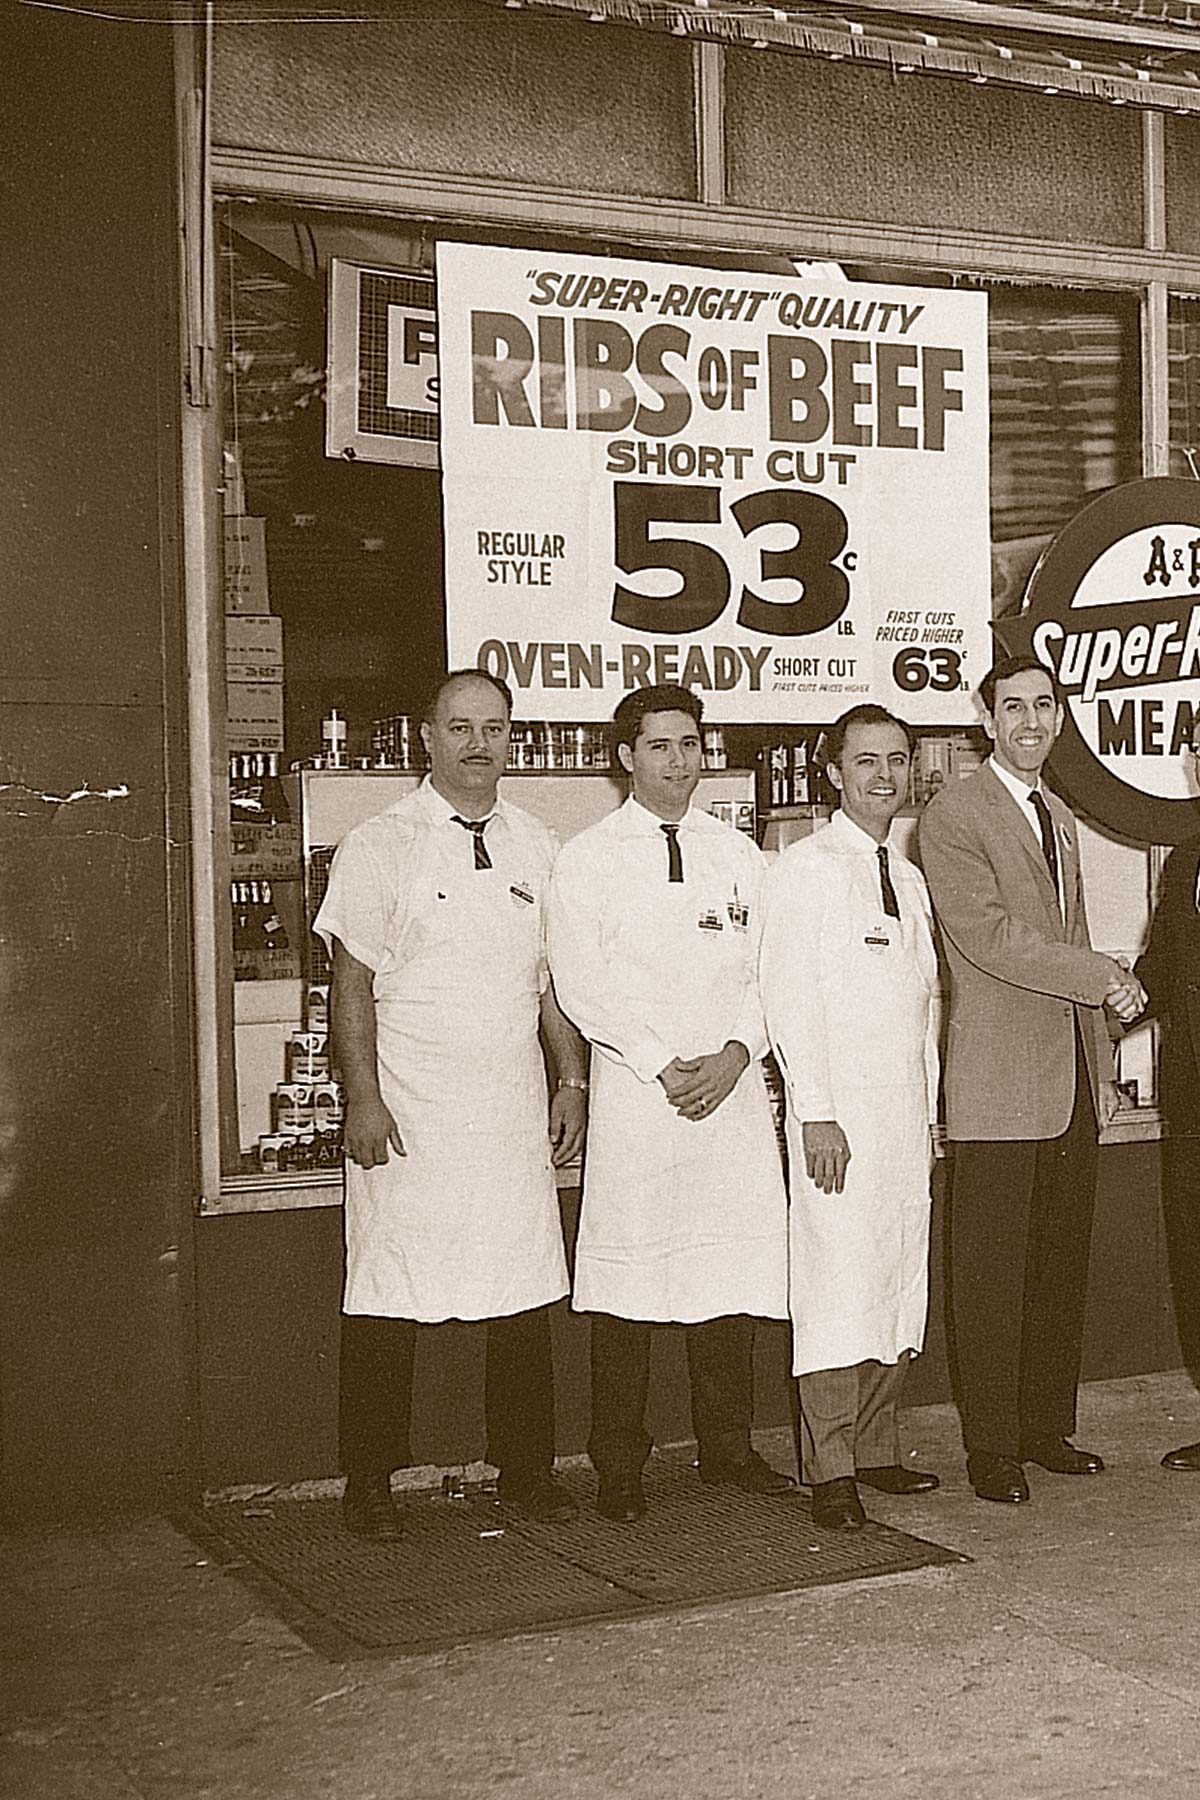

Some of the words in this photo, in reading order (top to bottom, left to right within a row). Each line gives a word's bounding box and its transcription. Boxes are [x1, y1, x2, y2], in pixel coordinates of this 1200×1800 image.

[777, 292, 925, 334] QUALITY
[470, 310, 692, 437] RIBS
[698, 346, 759, 411] OF
[767, 333, 964, 451] BEEF
[606, 440, 753, 480] SHORT
[766, 449, 857, 485] CUT
[477, 531, 565, 559] REGULAR
[611, 480, 851, 636] 53
[487, 559, 552, 586] STYLE
[875, 627, 919, 642] PRICED
[920, 628, 964, 644] HIGHER
[886, 610, 921, 624] FIRST
[925, 611, 956, 626] CUTS
[477, 638, 773, 691] OVEN-READY
[773, 658, 820, 677] SHORT
[827, 658, 857, 677] CUT
[892, 647, 962, 692] 63
